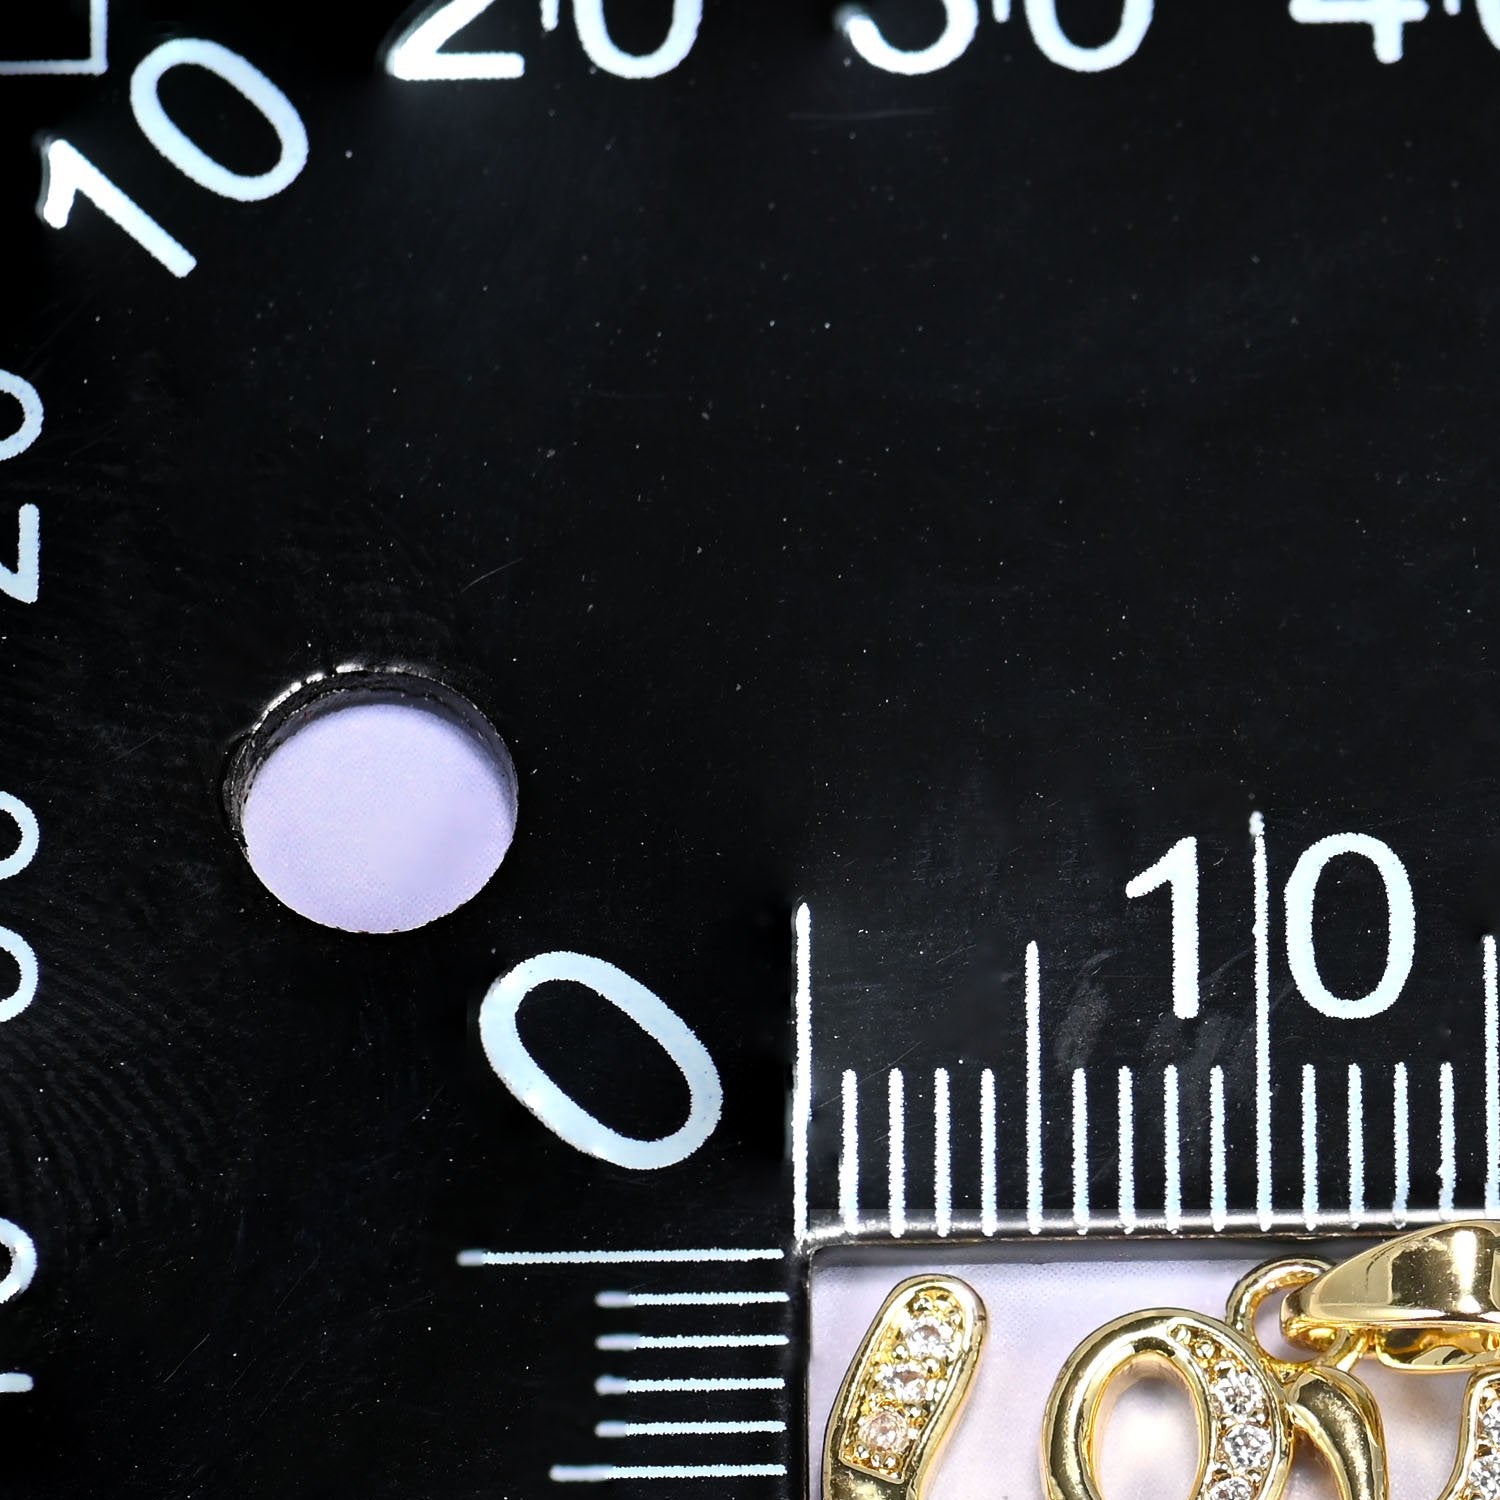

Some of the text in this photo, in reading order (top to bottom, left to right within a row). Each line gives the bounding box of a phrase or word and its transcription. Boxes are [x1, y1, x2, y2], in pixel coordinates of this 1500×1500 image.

[39, 39, 308, 278] 10
[1125, 832, 1416, 1020] 10
[479, 951, 723, 1170] 0
